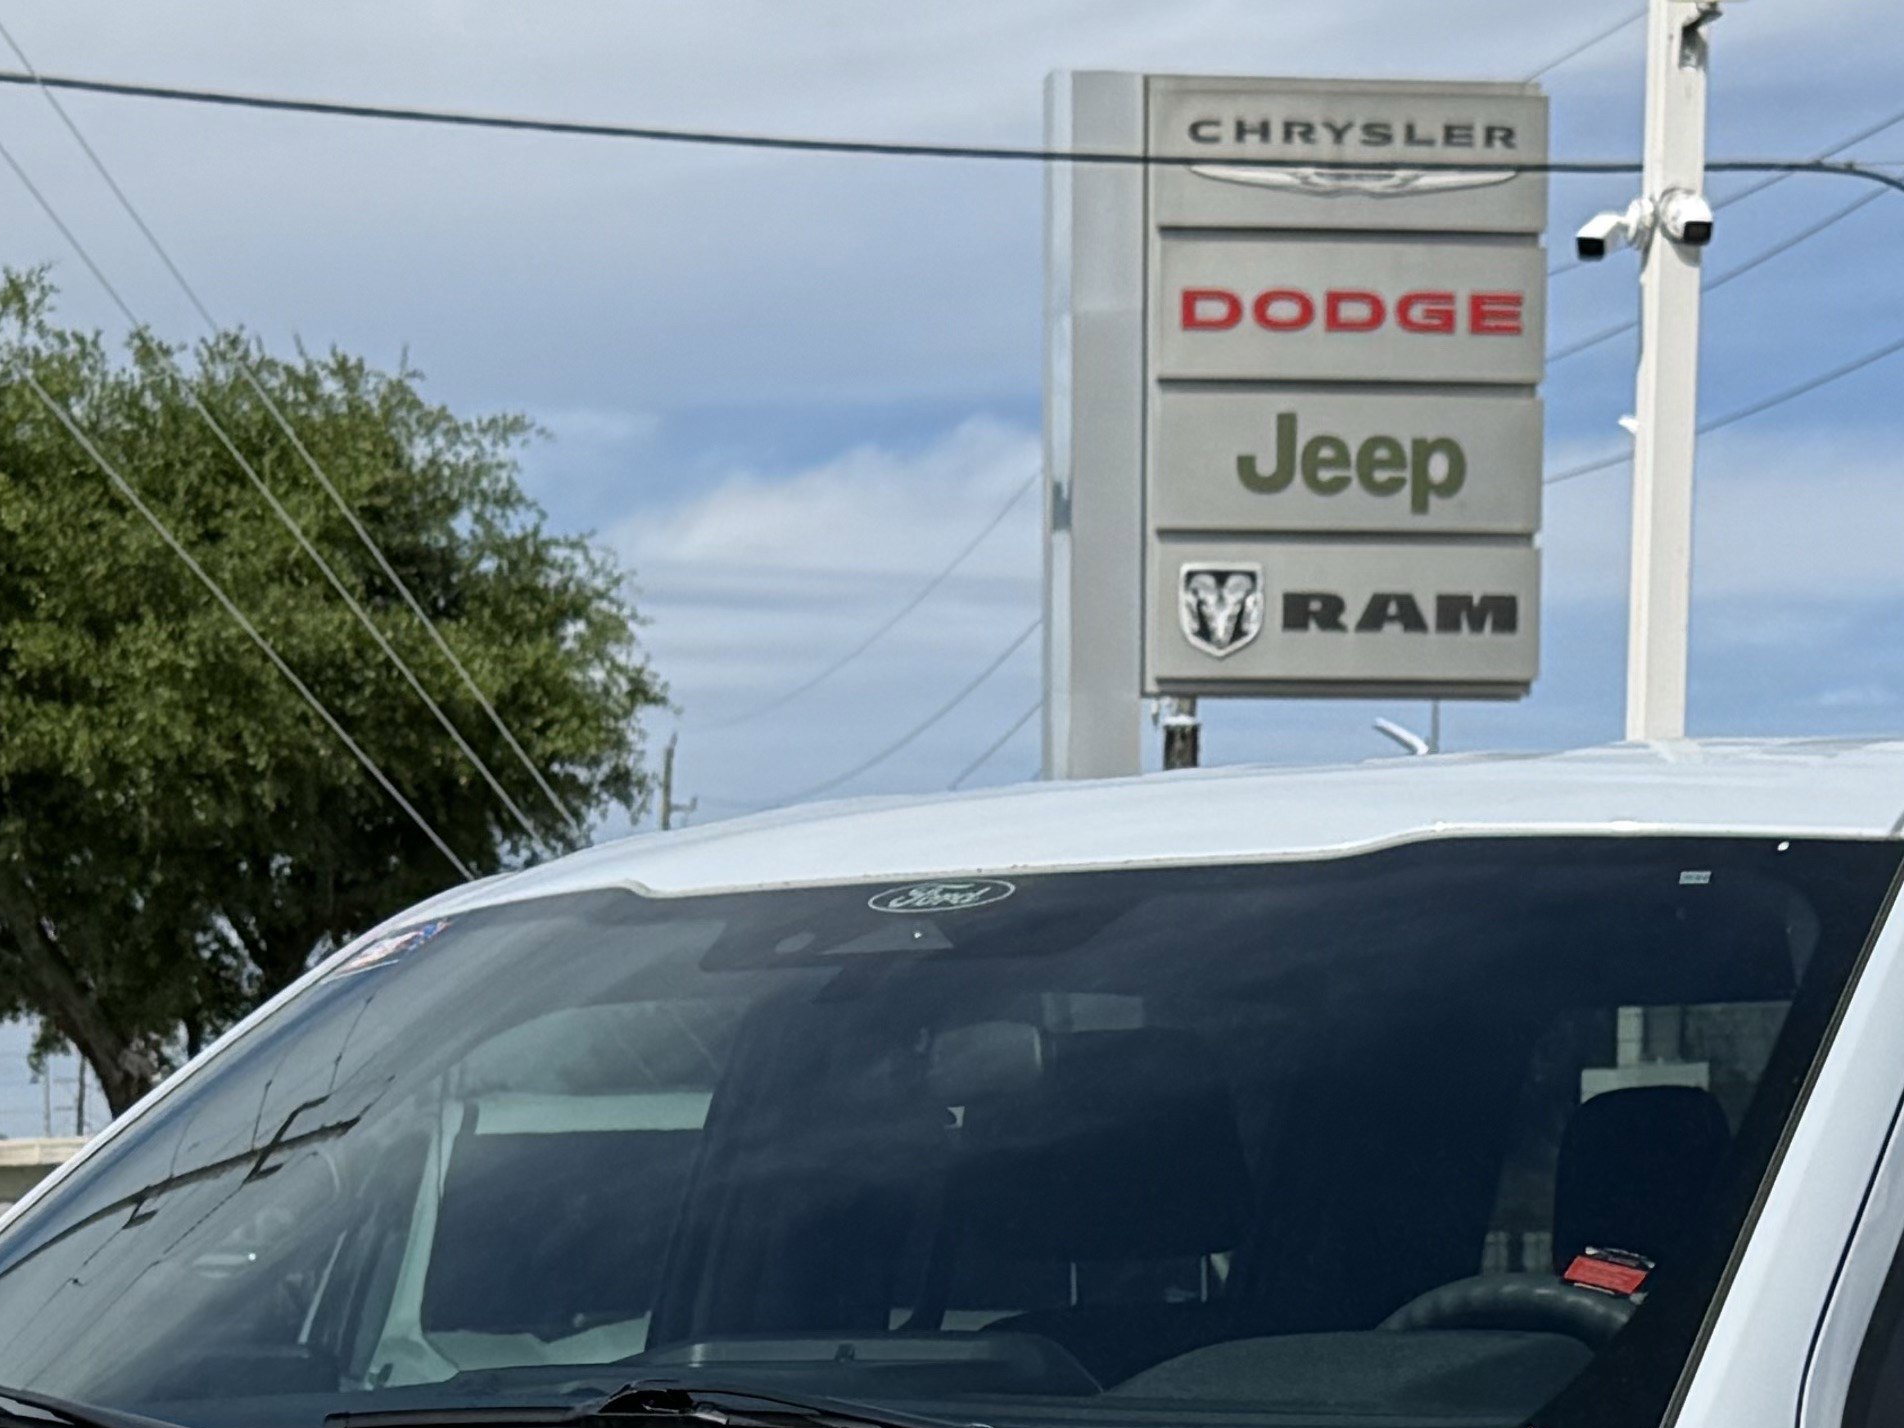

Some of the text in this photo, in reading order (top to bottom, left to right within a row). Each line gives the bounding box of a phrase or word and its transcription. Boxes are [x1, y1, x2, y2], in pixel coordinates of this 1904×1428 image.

[1188, 119, 1518, 150] CHRYSLER
[1180, 288, 1524, 335] DODGE
[1236, 411, 1467, 515] Jeep
[1281, 590, 1519, 635] RAM
[887, 882, 992, 909] Ford
